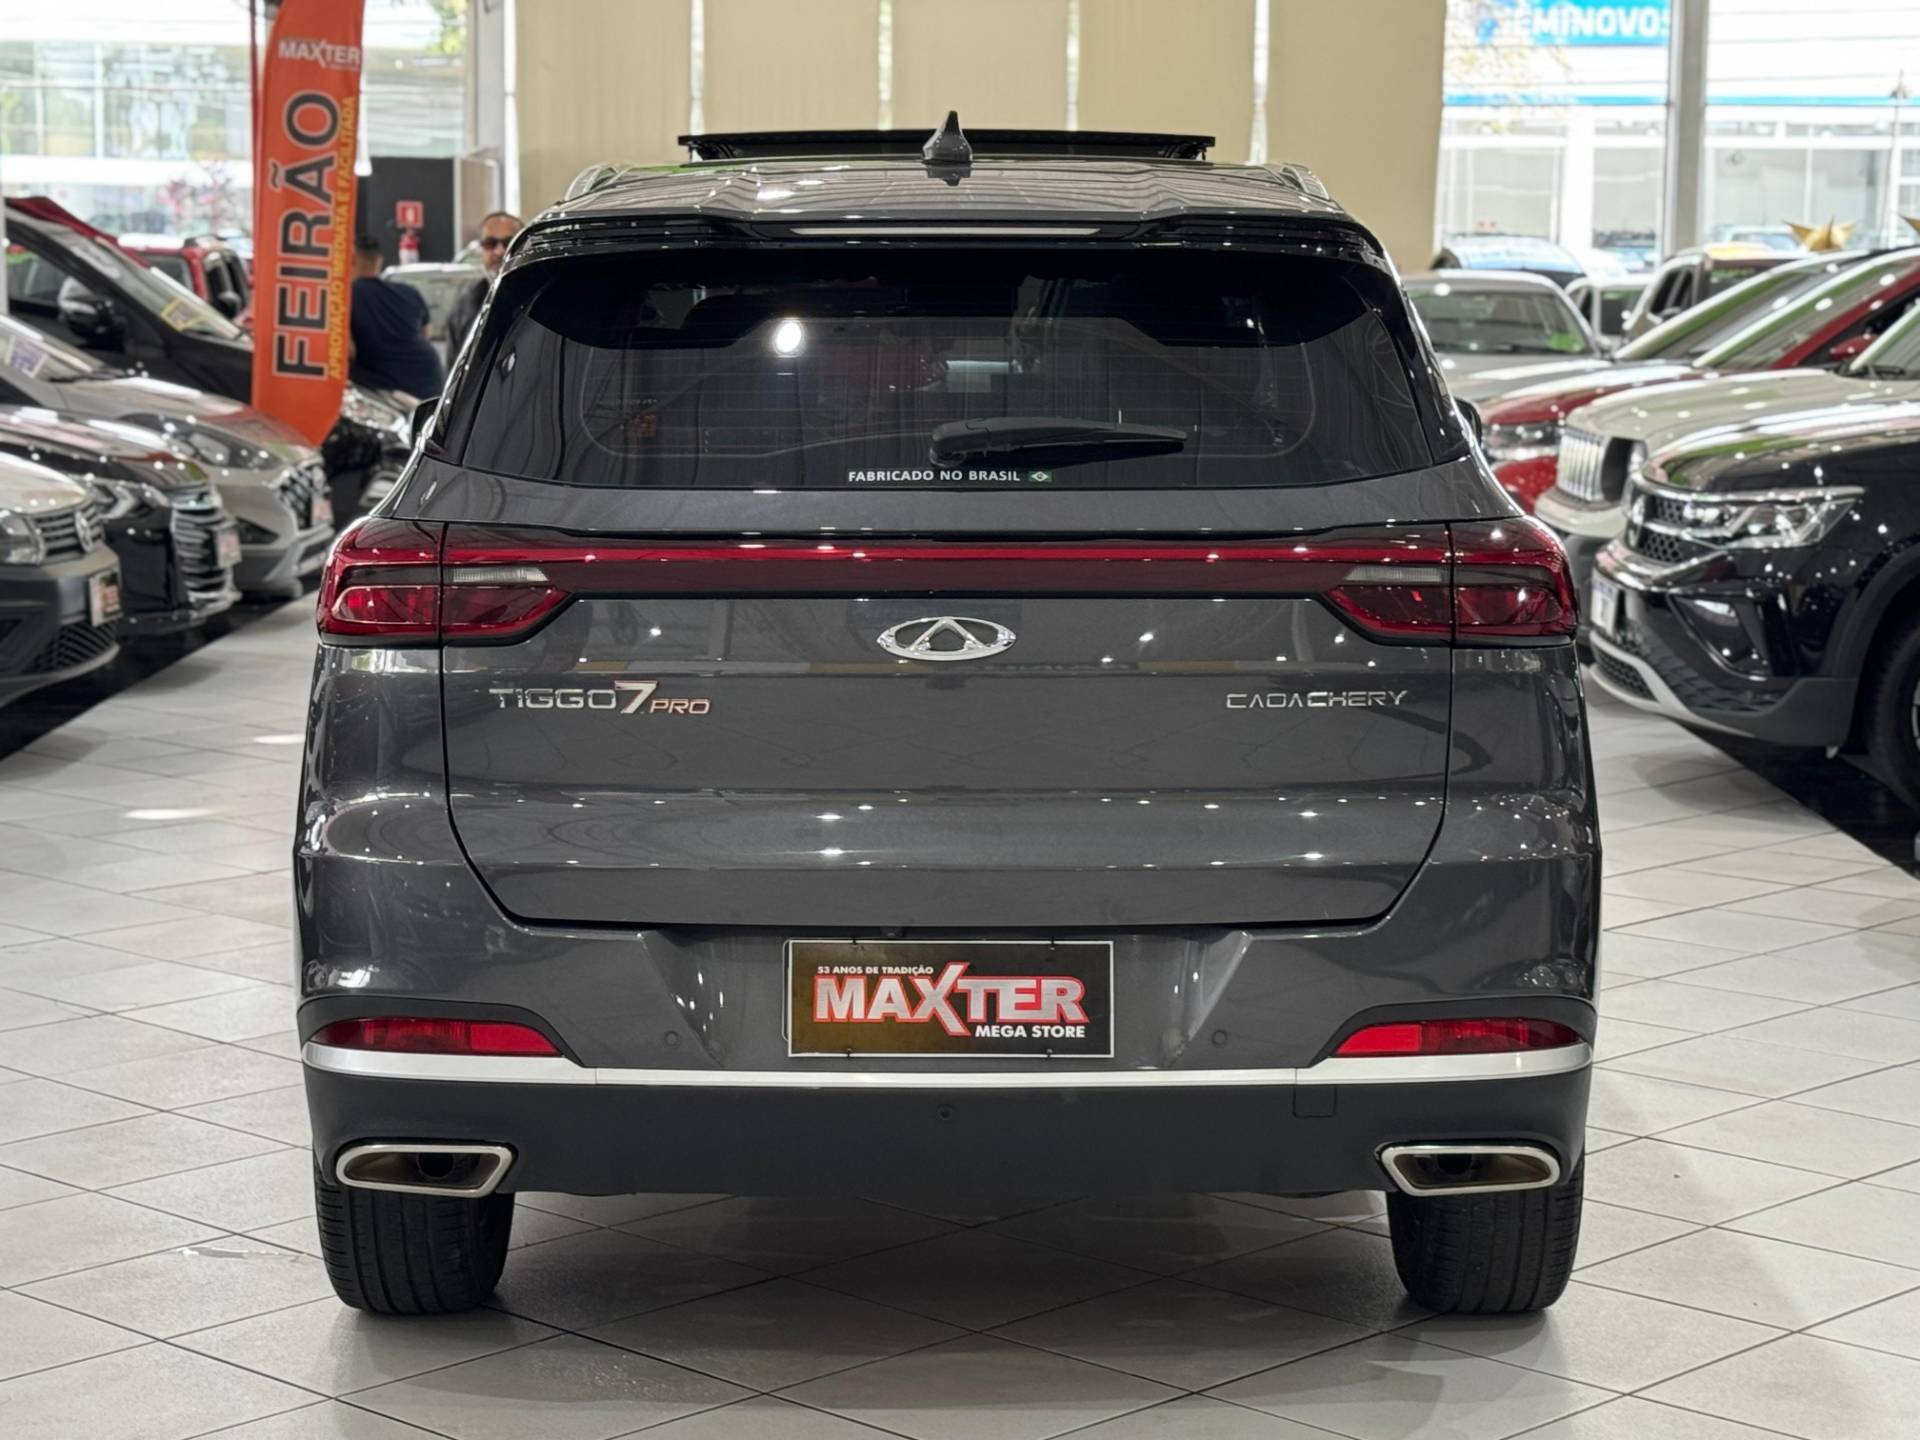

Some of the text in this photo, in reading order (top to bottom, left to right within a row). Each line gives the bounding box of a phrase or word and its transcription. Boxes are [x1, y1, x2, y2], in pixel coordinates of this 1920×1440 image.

[278, 38, 361, 69] MAXTER
[336, 96, 356, 189] FACILITADA
[269, 90, 342, 381] FEIRÃO
[331, 205, 349, 278] IMEDIATA
[328, 280, 346, 380] APROVAÇÃO
[848, 470, 1021, 482] FABRICADO NO BRASIL
[814, 961, 1089, 1036] MAXTER
[817, 964, 934, 977] 53 ANOS DE TRADIÇÃO
[975, 1024, 1085, 1038] MEGA STORE
